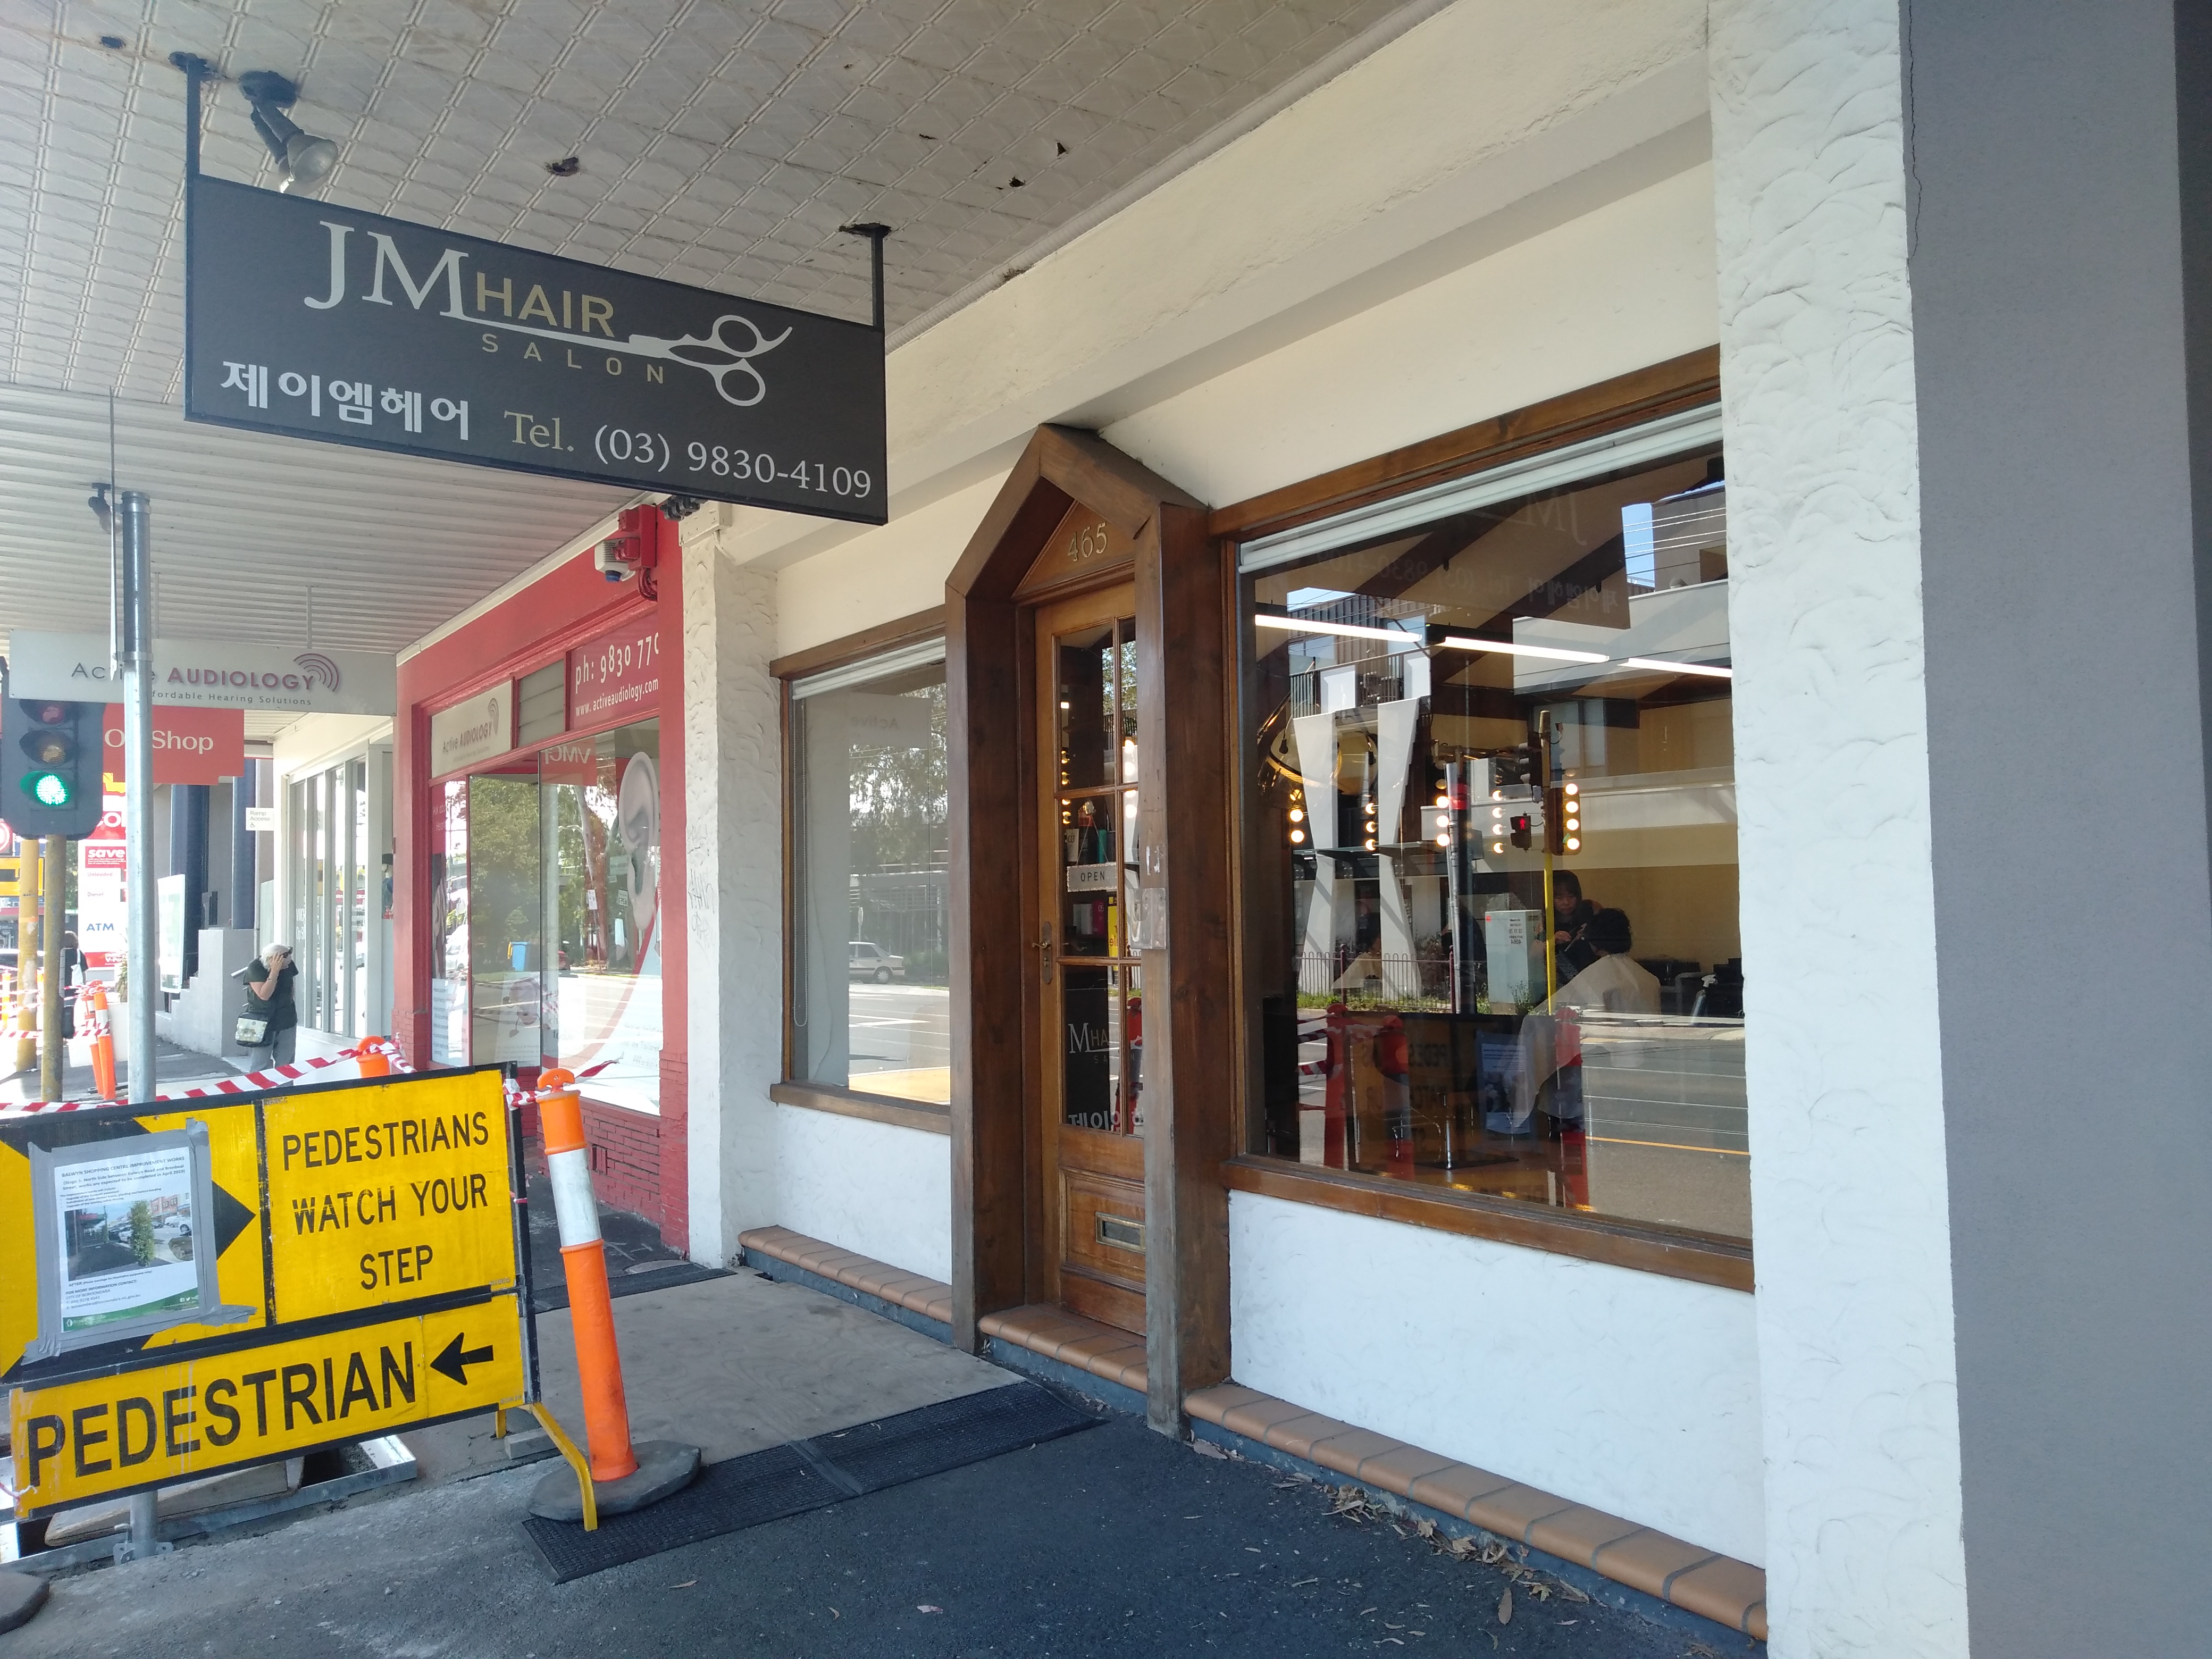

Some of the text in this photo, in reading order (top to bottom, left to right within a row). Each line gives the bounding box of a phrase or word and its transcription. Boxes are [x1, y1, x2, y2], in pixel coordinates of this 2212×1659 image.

[304, 221, 615, 338] JM HAIR
[482, 333, 664, 384] SALON
[220, 361, 469, 441] 제이엠헤어
[504, 410, 872, 498] Tel. (03) 9830-4109
[1066, 522, 1108, 562] 465
[167, 667, 314, 690] AUDIOLOGY
[575, 655, 594, 694] ph:
[600, 644, 631, 684] 9830
[208, 693, 253, 704] Hearing
[259, 696, 312, 706] Solutions
[575, 678, 659, 717] www. activeaudiology.com
[152, 731, 214, 755] Shop
[459, 720, 492, 747] AUDIOLOGY
[88, 849, 126, 858] save
[1080, 871, 1105, 882] OPEN
[283, 1111, 489, 1171] PEDESTRIANS
[292, 1173, 488, 1235] WATCH YOUR
[360, 1245, 433, 1290] STEP
[27, 1341, 416, 1487] PEDESTRIAN
